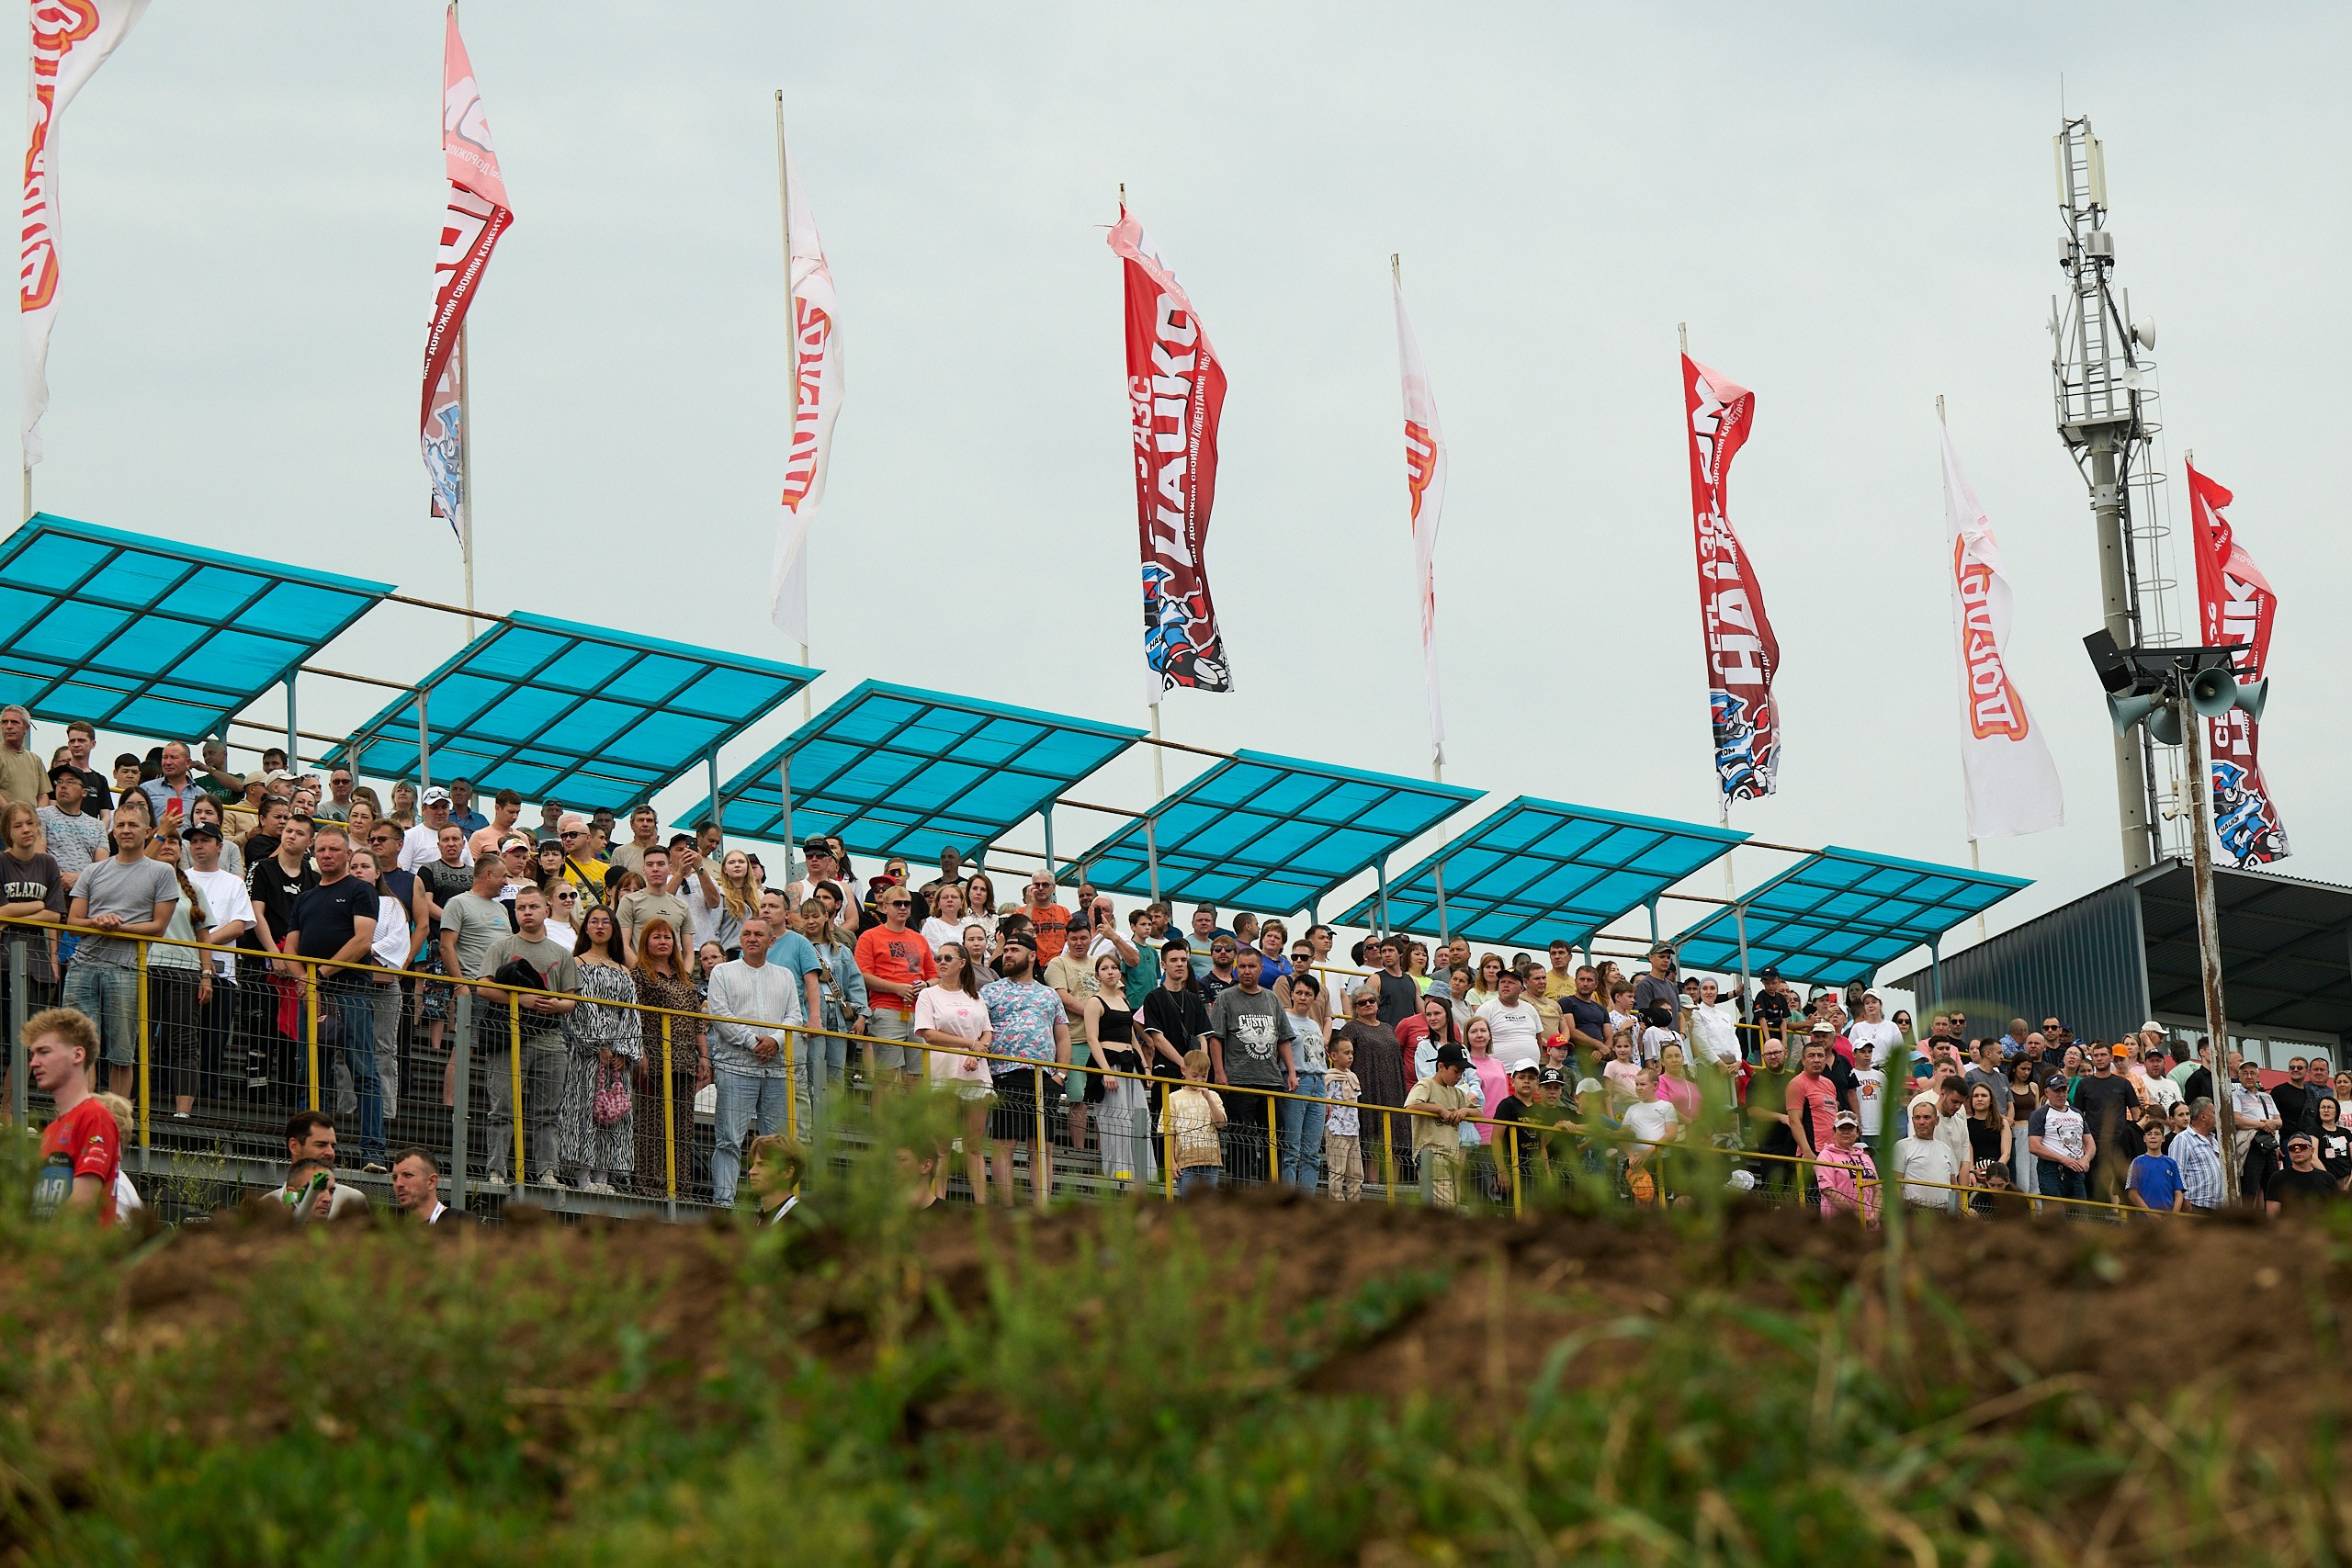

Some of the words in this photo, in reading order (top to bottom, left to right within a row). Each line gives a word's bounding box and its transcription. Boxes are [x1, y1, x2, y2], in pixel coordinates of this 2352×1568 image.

[428, 299, 458, 356] ДОРОЖИМ
[452, 257, 483, 299] СВОИМИ
[1193, 375, 1206, 439] КЛИЕНТАМИ!
[1190, 437, 1200, 481] СВОИМИ
[1698, 512, 1717, 583] АЗС
[1706, 592, 1724, 675] СЕТЬ
